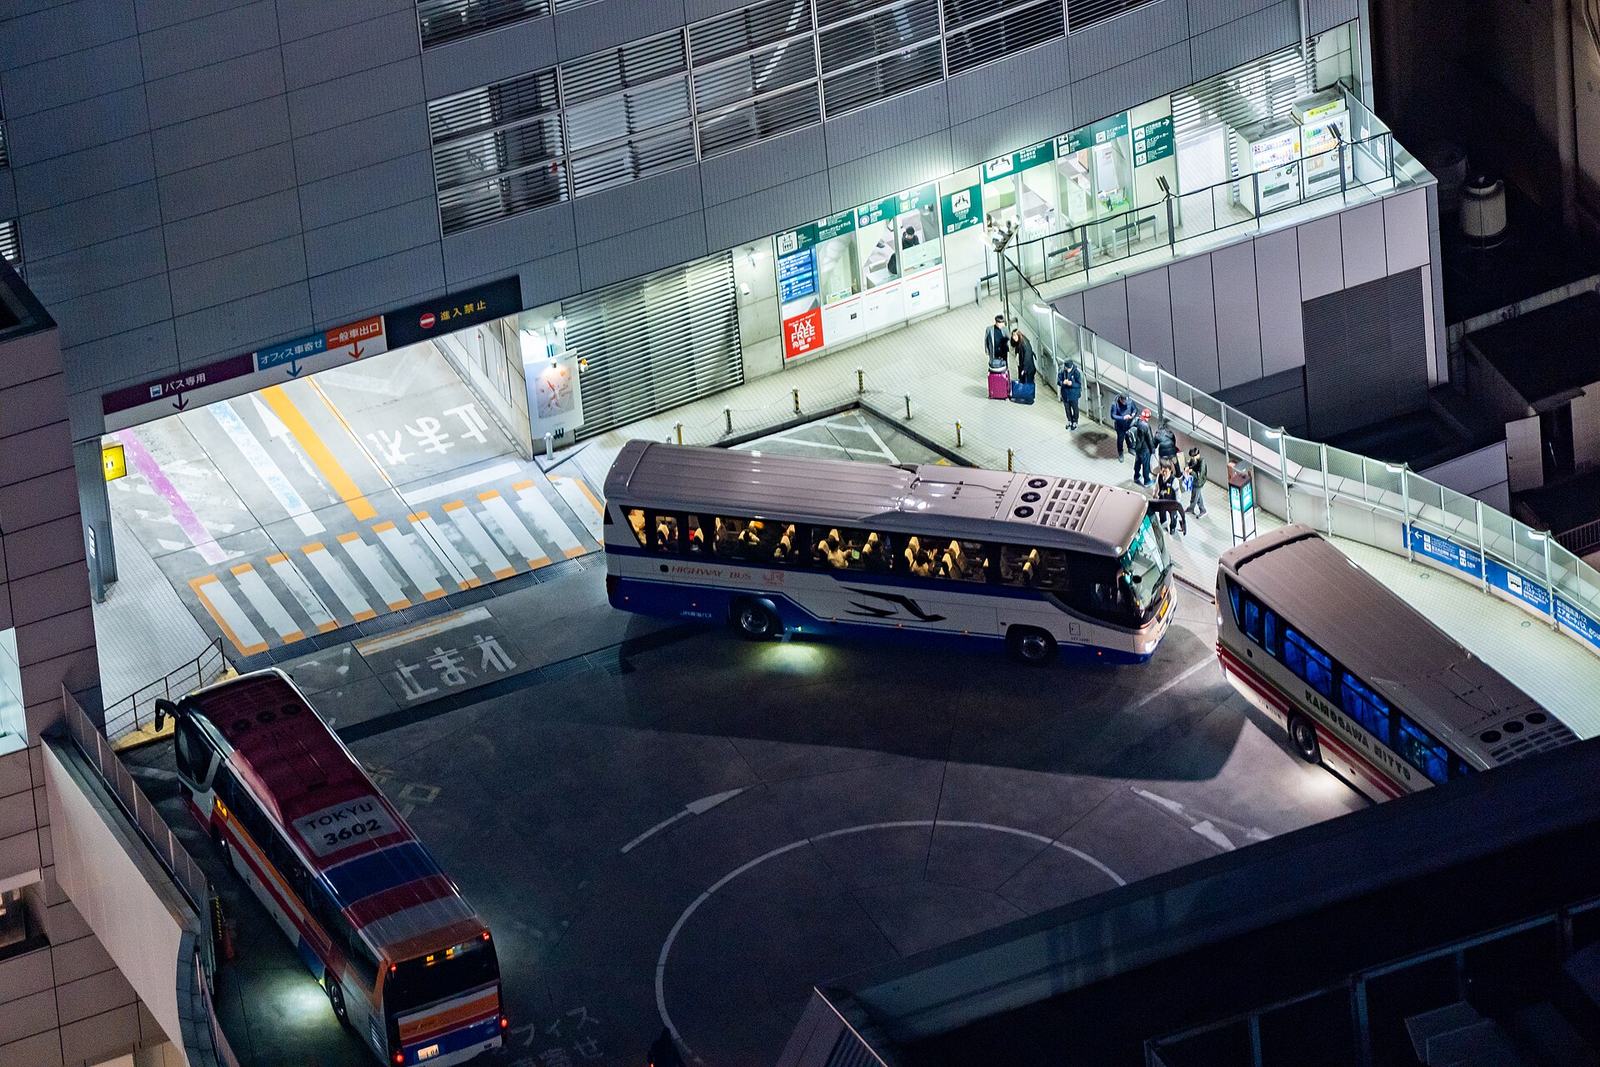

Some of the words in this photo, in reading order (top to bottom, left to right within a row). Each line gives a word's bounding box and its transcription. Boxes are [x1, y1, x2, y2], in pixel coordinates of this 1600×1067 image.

[440, 300, 486, 321] 進入禁止
[329, 322, 379, 342] 一般車出口
[791, 325, 816, 343] FREE
[792, 318, 812, 333] TAX
[260, 340, 322, 364] オフィス車寄せ
[165, 372, 206, 393] バス専用
[366, 402, 489, 465] 止まれ
[671, 565, 724, 577] HIGHWAY
[393, 634, 518, 700] 止まれ
[1304, 689, 1370, 749] KAMOGAWA
[1373, 743, 1412, 782] NITTO
[306, 802, 374, 831] TOKYU
[323, 818, 383, 846] 3602
